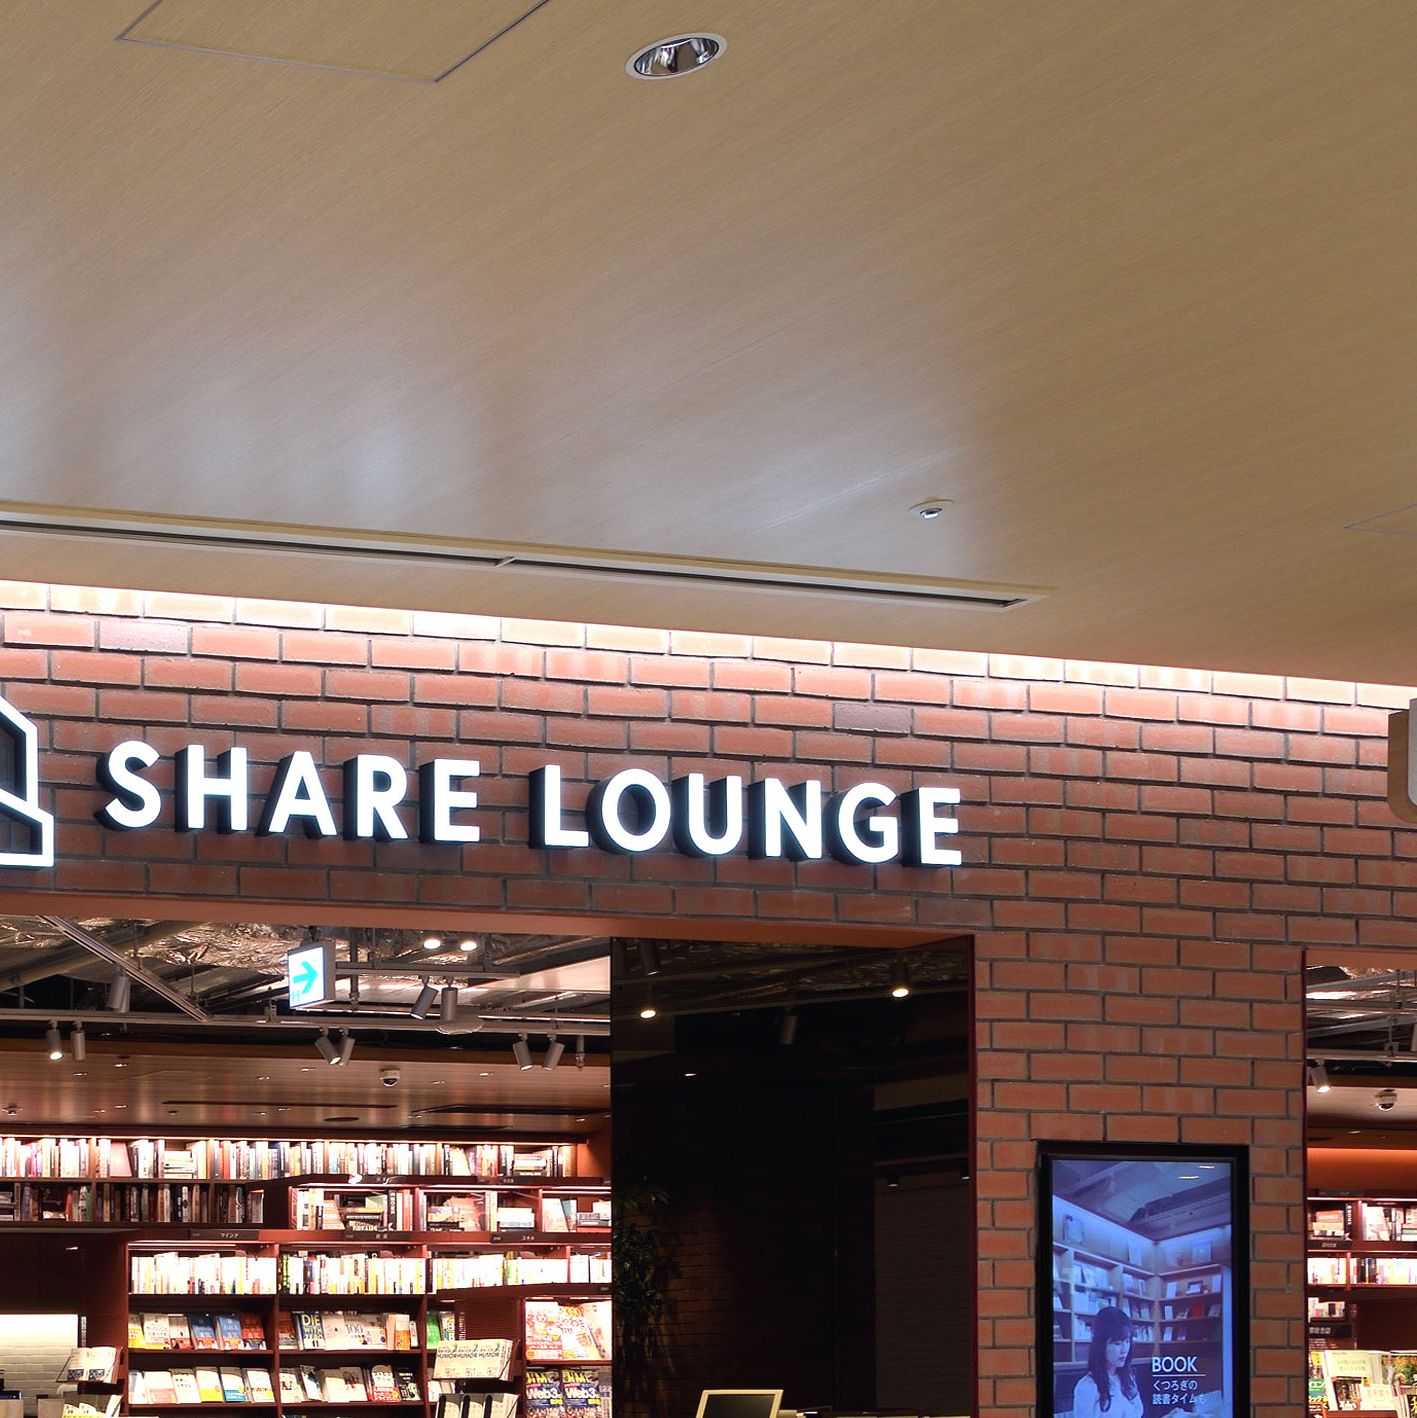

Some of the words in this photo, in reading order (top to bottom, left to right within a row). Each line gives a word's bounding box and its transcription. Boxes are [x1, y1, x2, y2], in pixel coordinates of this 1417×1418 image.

[106, 741, 479, 841] SHARE
[545, 765, 961, 865] LOUNGE
[301, 1314, 321, 1326] DIE
[1152, 1356, 1198, 1372] BOOK
[1153, 1379, 1198, 1391] くつろぎの
[1152, 1393, 1206, 1405] 読書タイムも
